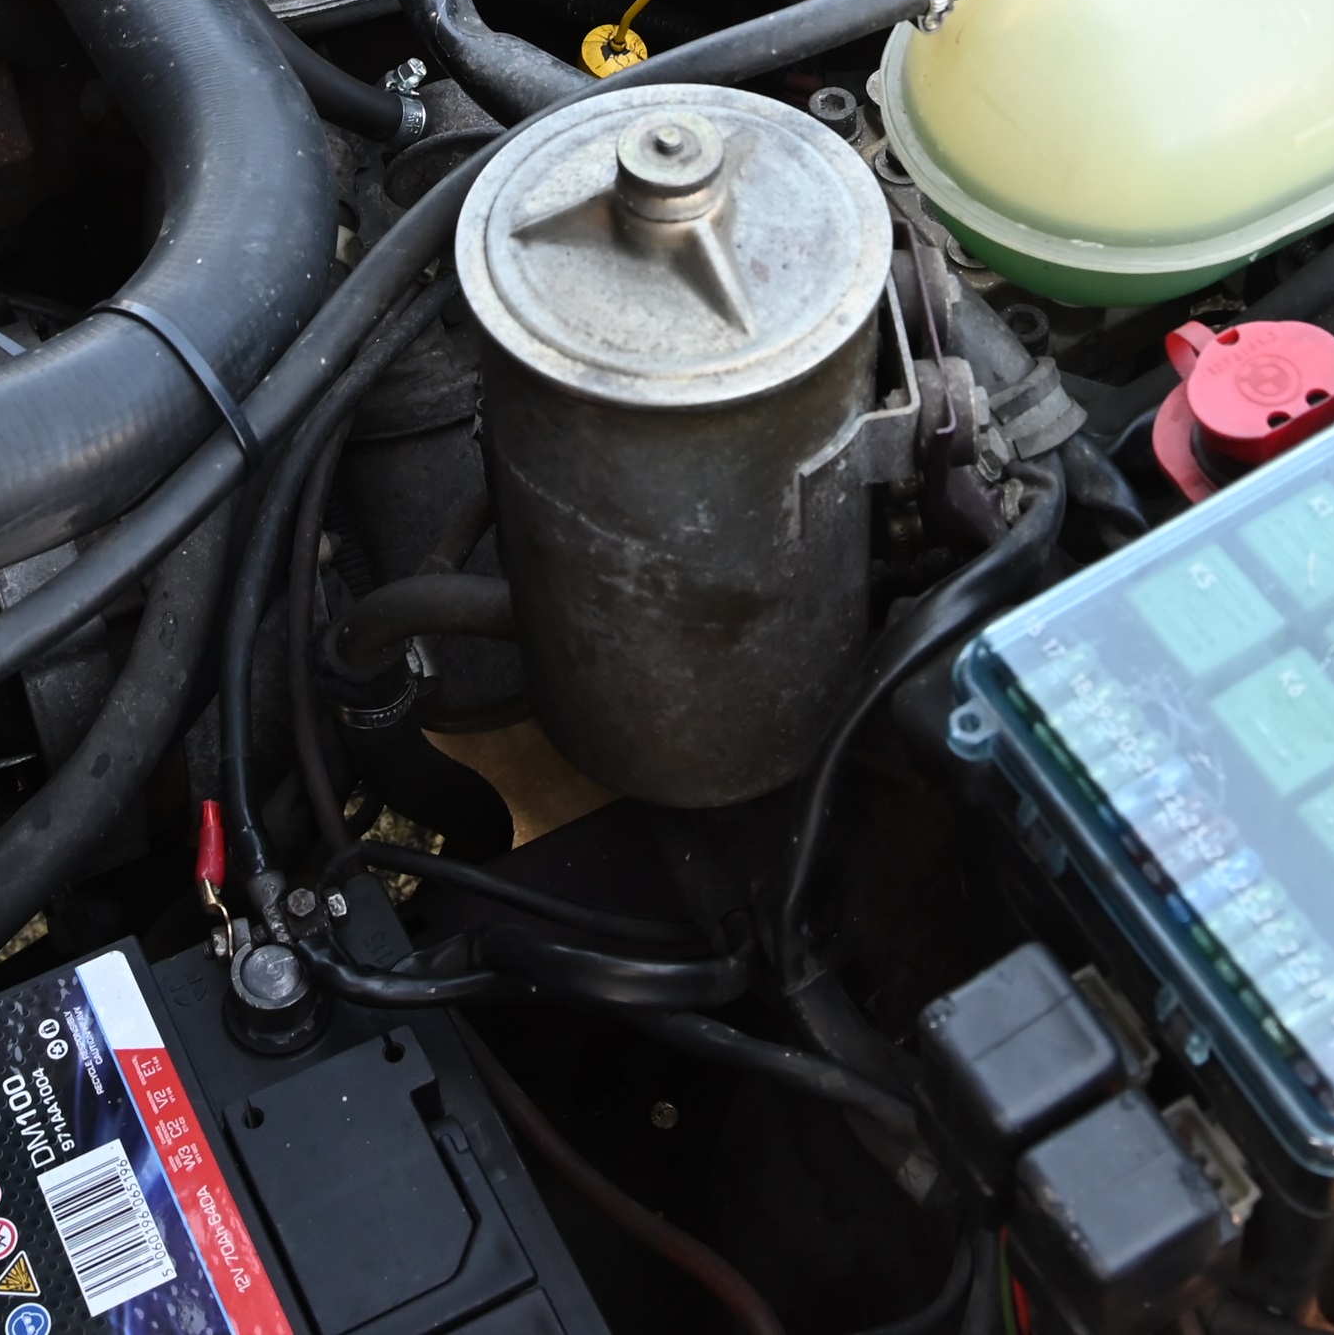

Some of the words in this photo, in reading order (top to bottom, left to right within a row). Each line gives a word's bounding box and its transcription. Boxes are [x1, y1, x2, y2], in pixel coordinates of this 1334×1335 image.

[1309, 493, 1334, 518] K1
[1188, 560, 1217, 591] K5
[1039, 635, 1067, 664] 17
[1278, 668, 1306, 699] K6
[72, 1005, 88, 1030] HEAVY
[63, 1009, 90, 1060] RESPONSIBLY
[84, 1030, 103, 1065] CAUTION
[84, 1059, 104, 1095] RECYCLE
[139, 1059, 156, 1077] E1
[30, 1065, 77, 1152] 971AA1004
[152, 1088, 170, 1108] V2
[0, 1072, 57, 1168] DM100
[165, 1118, 183, 1139] C2
[176, 1144, 197, 1171] W3
[116, 1157, 145, 1207] 065196
[194, 1184, 222, 1227] 640A
[137, 1209, 166, 1260] 060196
[212, 1224, 240, 1266] 70Ah
[161, 1267, 174, 1277] 5
[229, 1264, 252, 1294] 12V
